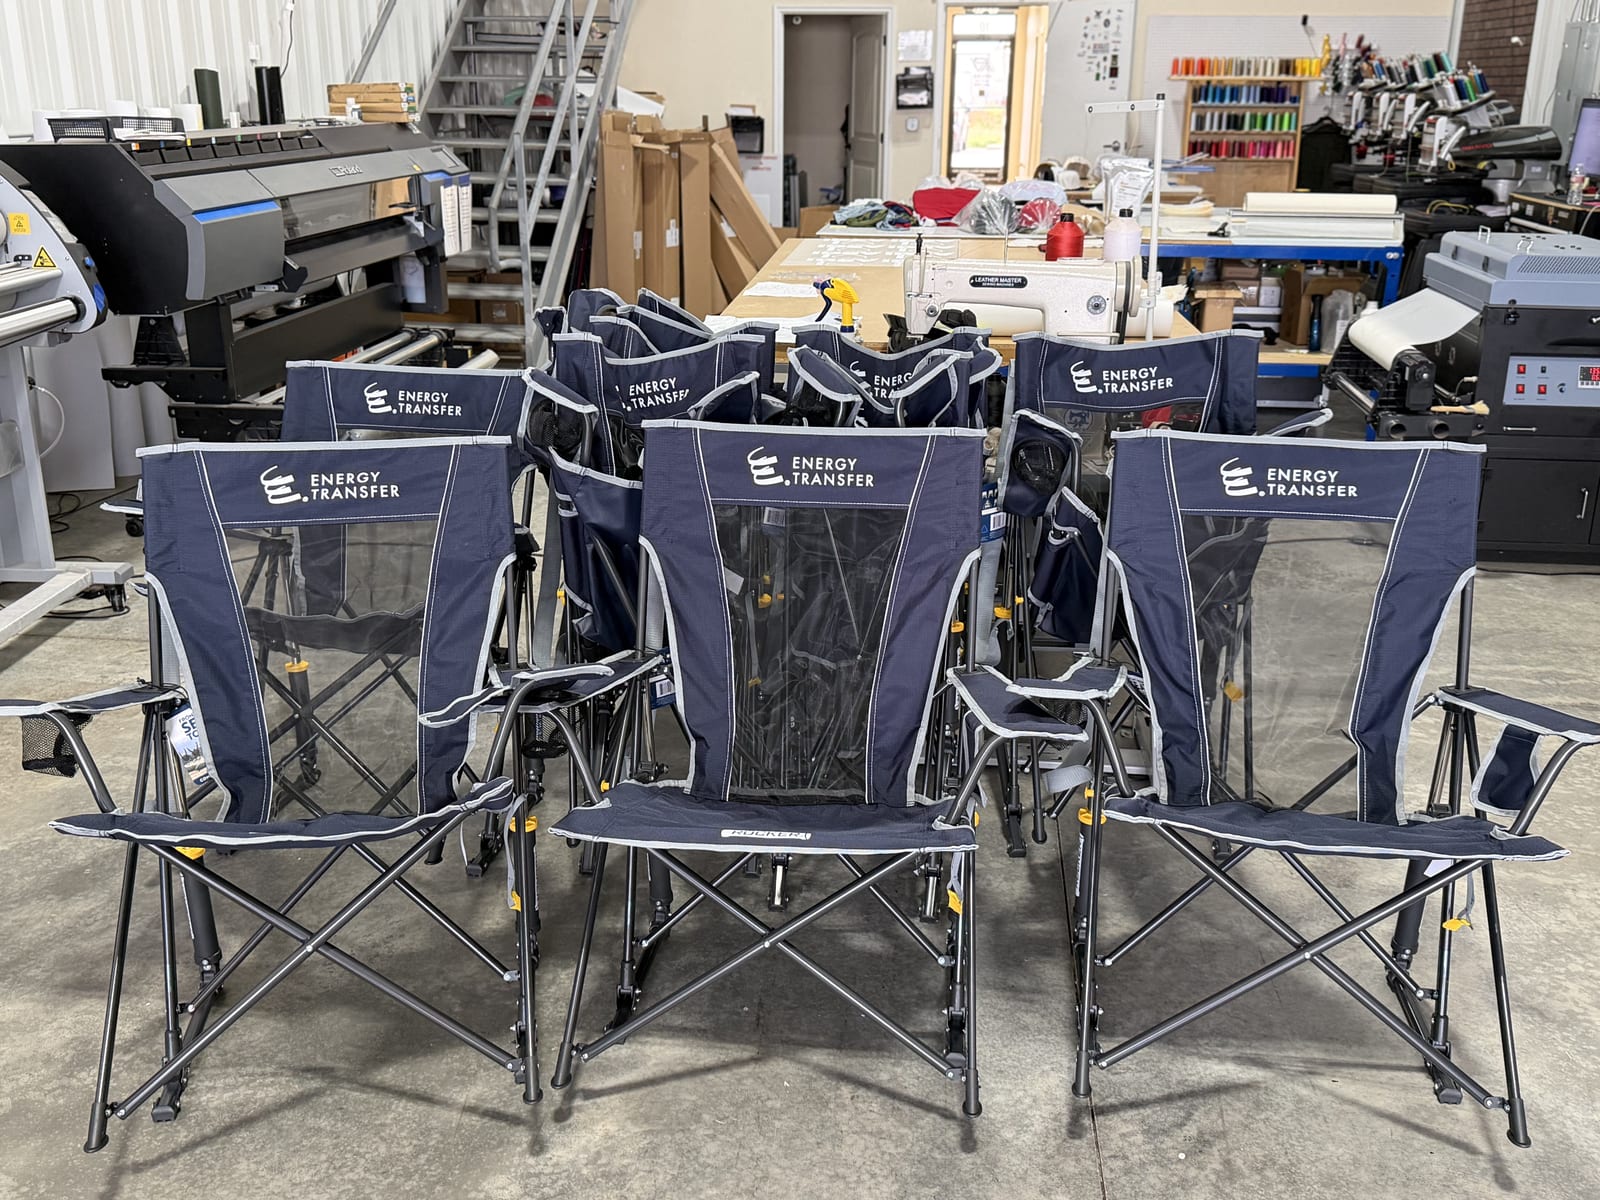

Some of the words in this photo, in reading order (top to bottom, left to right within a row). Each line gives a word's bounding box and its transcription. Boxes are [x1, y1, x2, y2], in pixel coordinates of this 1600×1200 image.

[874, 372, 913, 388] ENERG
[1102, 366, 1158, 381] ENERGY
[629, 377, 677, 396] ENERGY
[1103, 377, 1174, 393] TRANSFER
[398, 390, 450, 403] ENERGY
[398, 402, 462, 416] TRANSFER
[792, 456, 857, 471] ENERGY
[310, 471, 380, 487] ENERGY
[792, 472, 874, 487] TRANSFER
[1267, 468, 1339, 483] ENERGY
[310, 484, 400, 501] TRANSFER
[1267, 483, 1358, 497] TRANSFER
